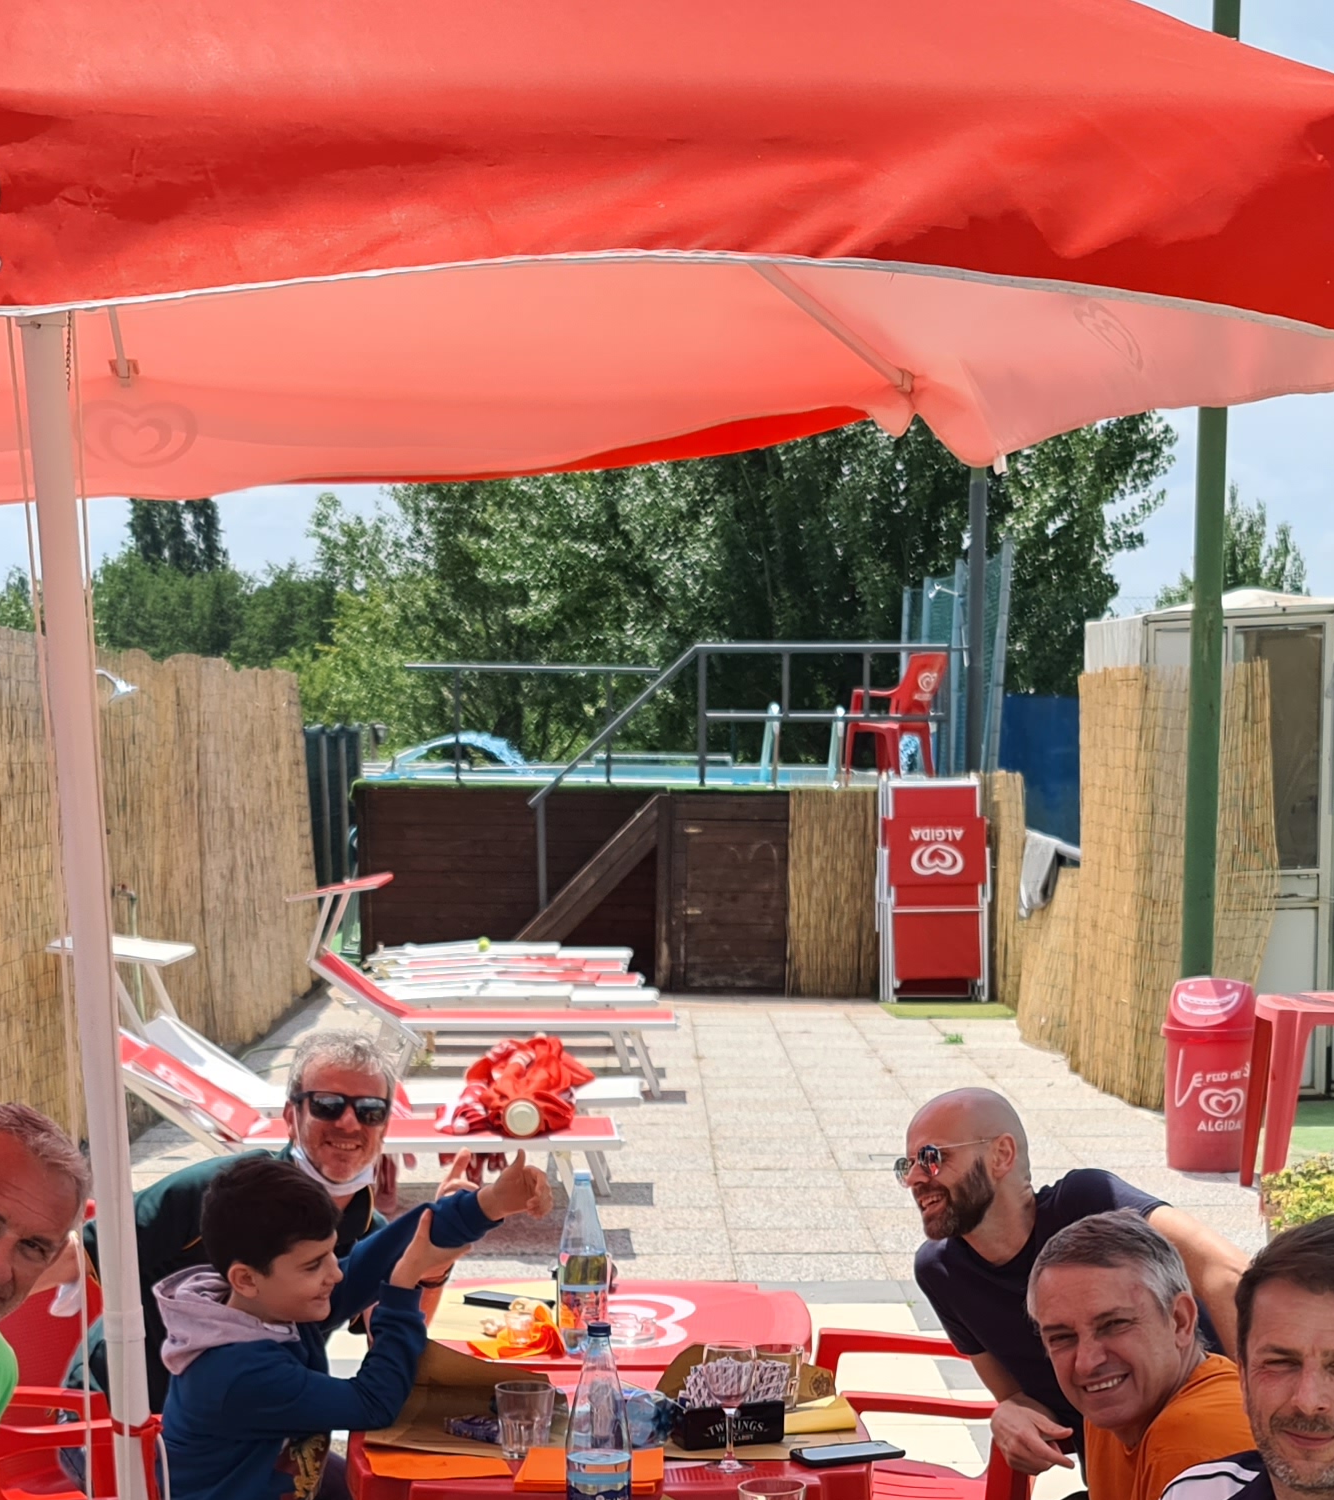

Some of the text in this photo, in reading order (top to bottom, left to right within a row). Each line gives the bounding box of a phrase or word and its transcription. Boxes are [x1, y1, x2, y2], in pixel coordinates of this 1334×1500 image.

[910, 825, 965, 842] ALGIDA
[1197, 1119, 1242, 1132] ALGIDA
[708, 1419, 765, 1437] TWNINGS
